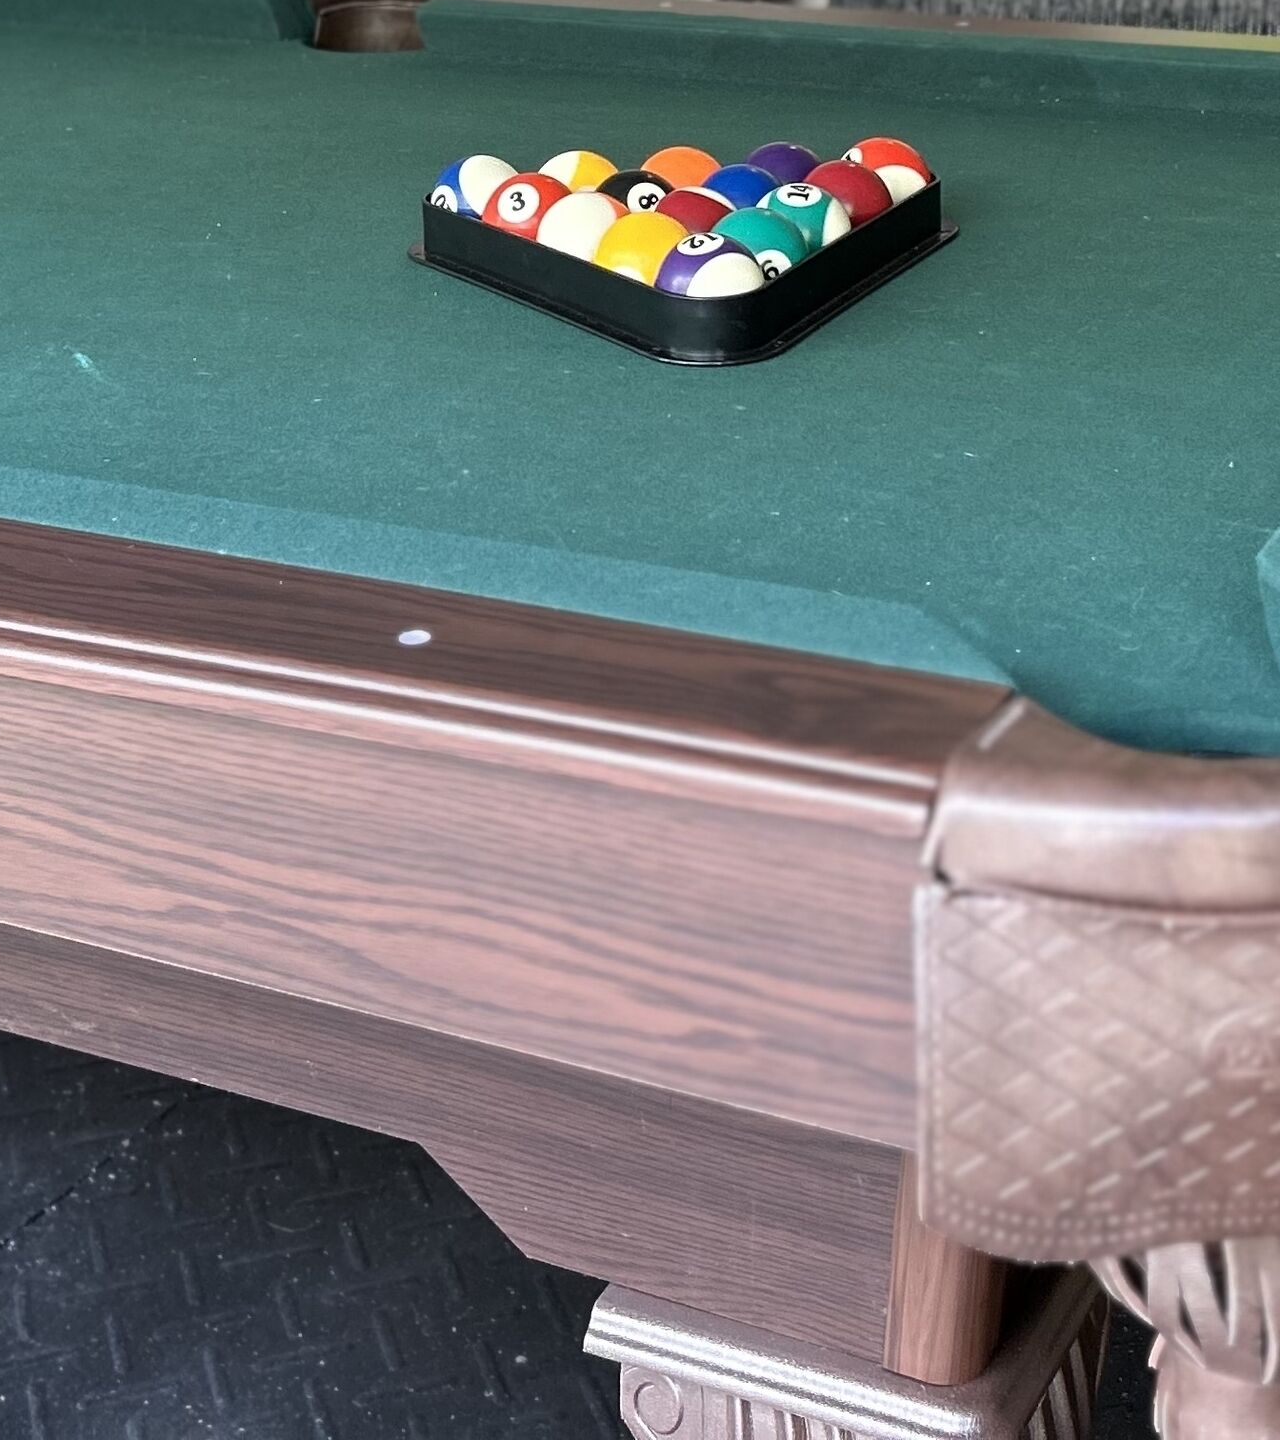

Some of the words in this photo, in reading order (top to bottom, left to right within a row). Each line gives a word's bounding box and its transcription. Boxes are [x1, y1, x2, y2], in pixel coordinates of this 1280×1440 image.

[638, 192, 659, 210] 8
[786, 184, 813, 201] 14
[510, 191, 526, 212] 3
[681, 233, 718, 249] 12
